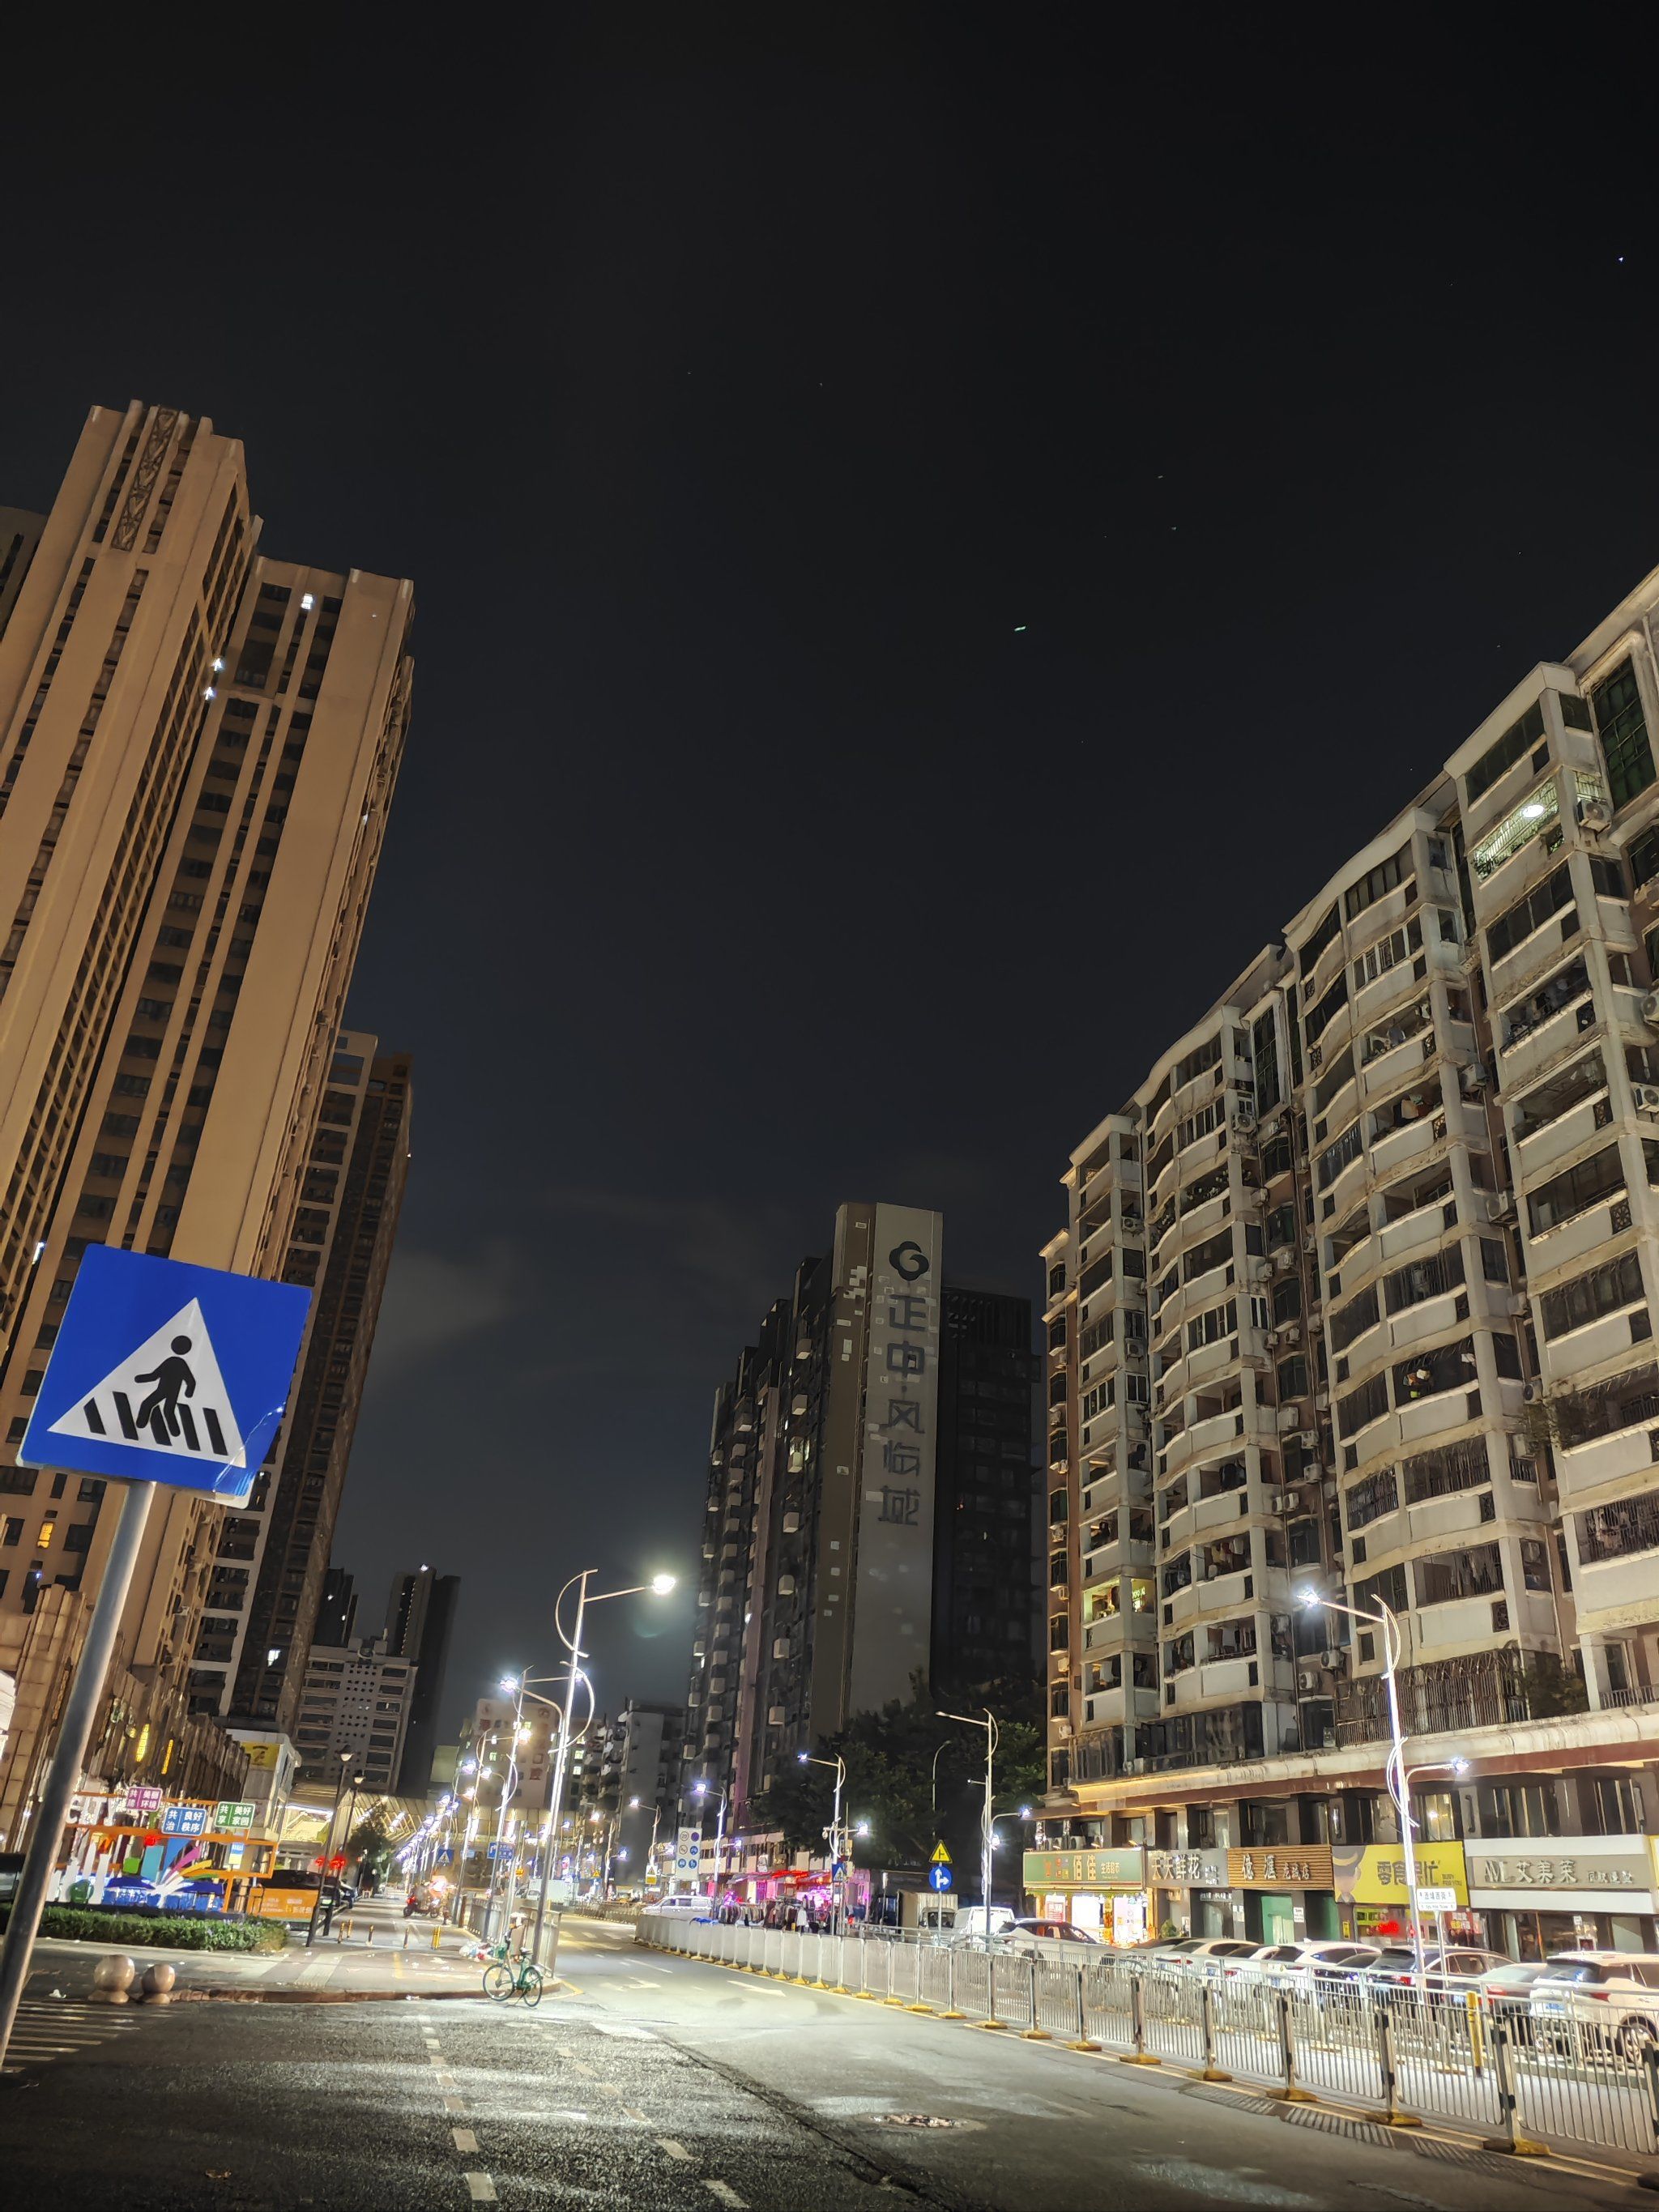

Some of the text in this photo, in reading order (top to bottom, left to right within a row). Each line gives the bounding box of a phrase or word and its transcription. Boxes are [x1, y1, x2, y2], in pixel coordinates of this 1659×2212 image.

[184, 1811, 203, 1822] 良好
[181, 1822, 201, 1833] 秩序
[1152, 1853, 1201, 1881] 天天鲜花
